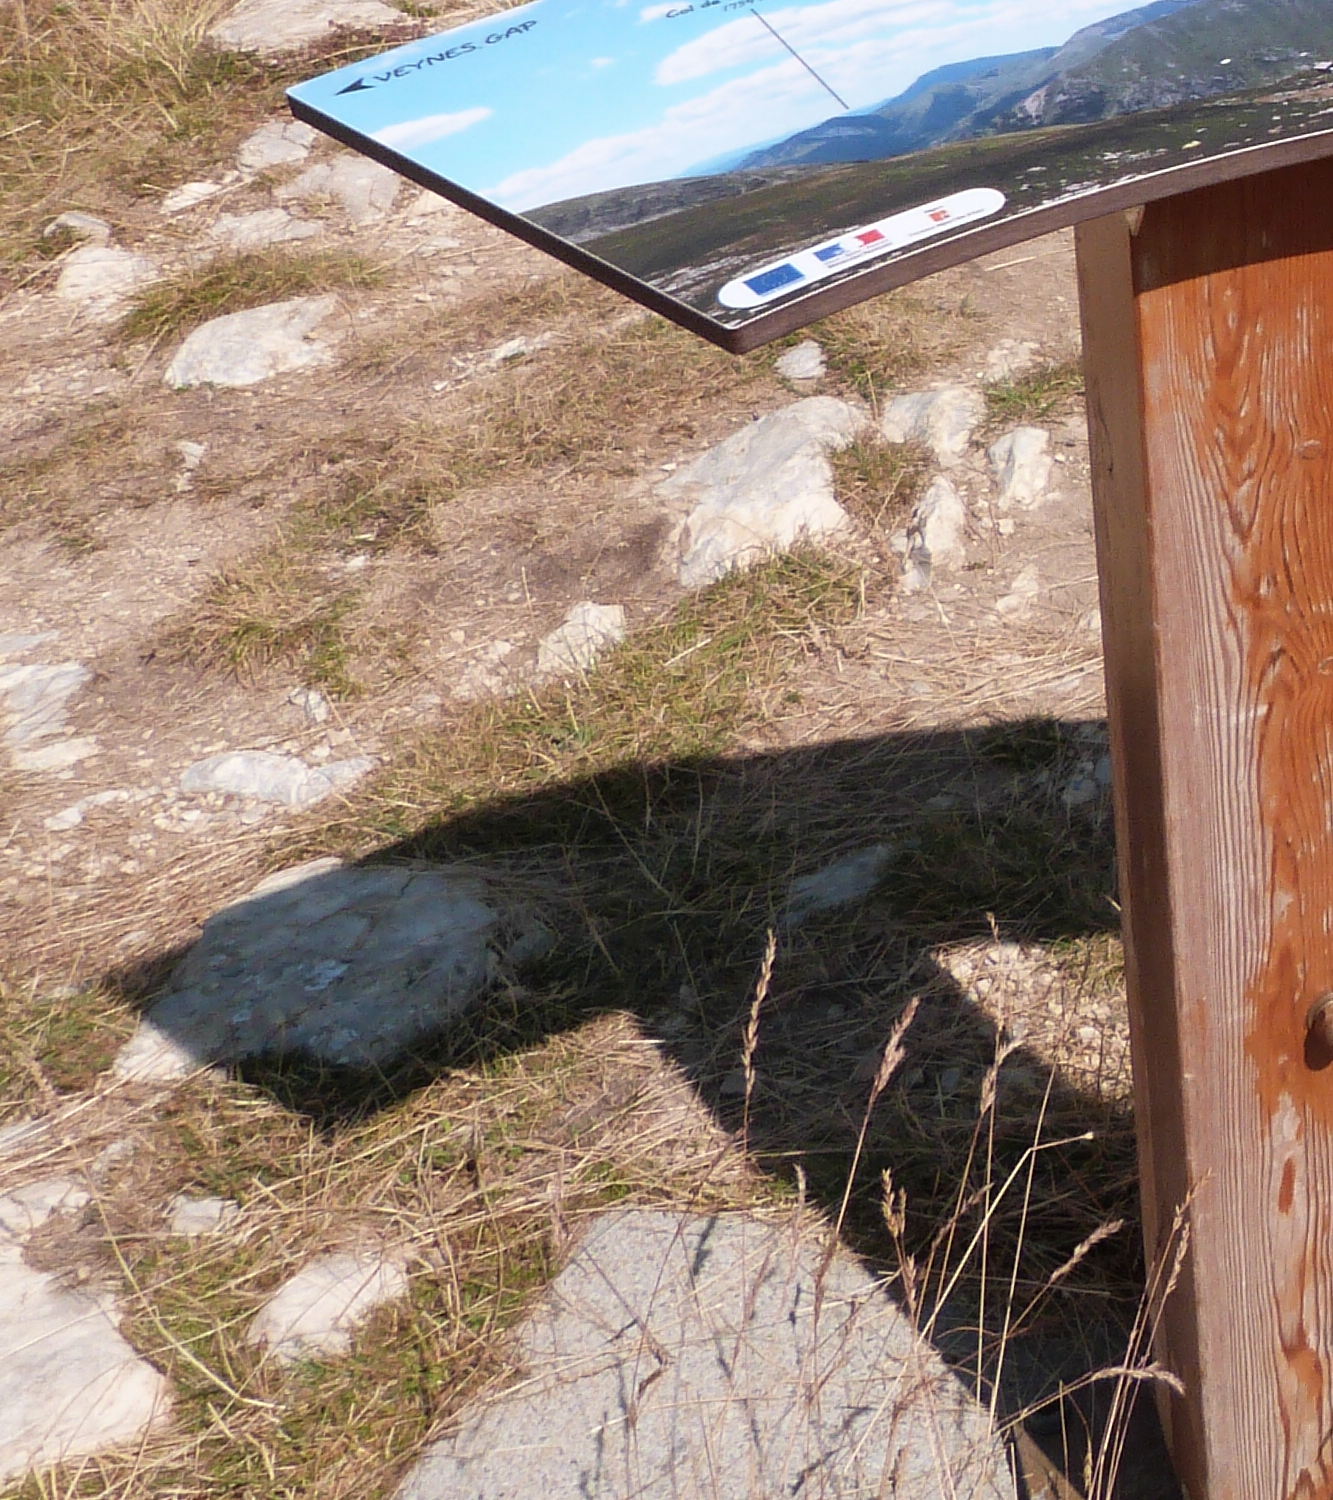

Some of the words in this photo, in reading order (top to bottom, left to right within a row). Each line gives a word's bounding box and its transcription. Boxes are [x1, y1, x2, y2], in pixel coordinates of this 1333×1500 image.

[666, 5, 694, 18] Col
[701, 0, 721, 8] de
[485, 20, 537, 44] GAP
